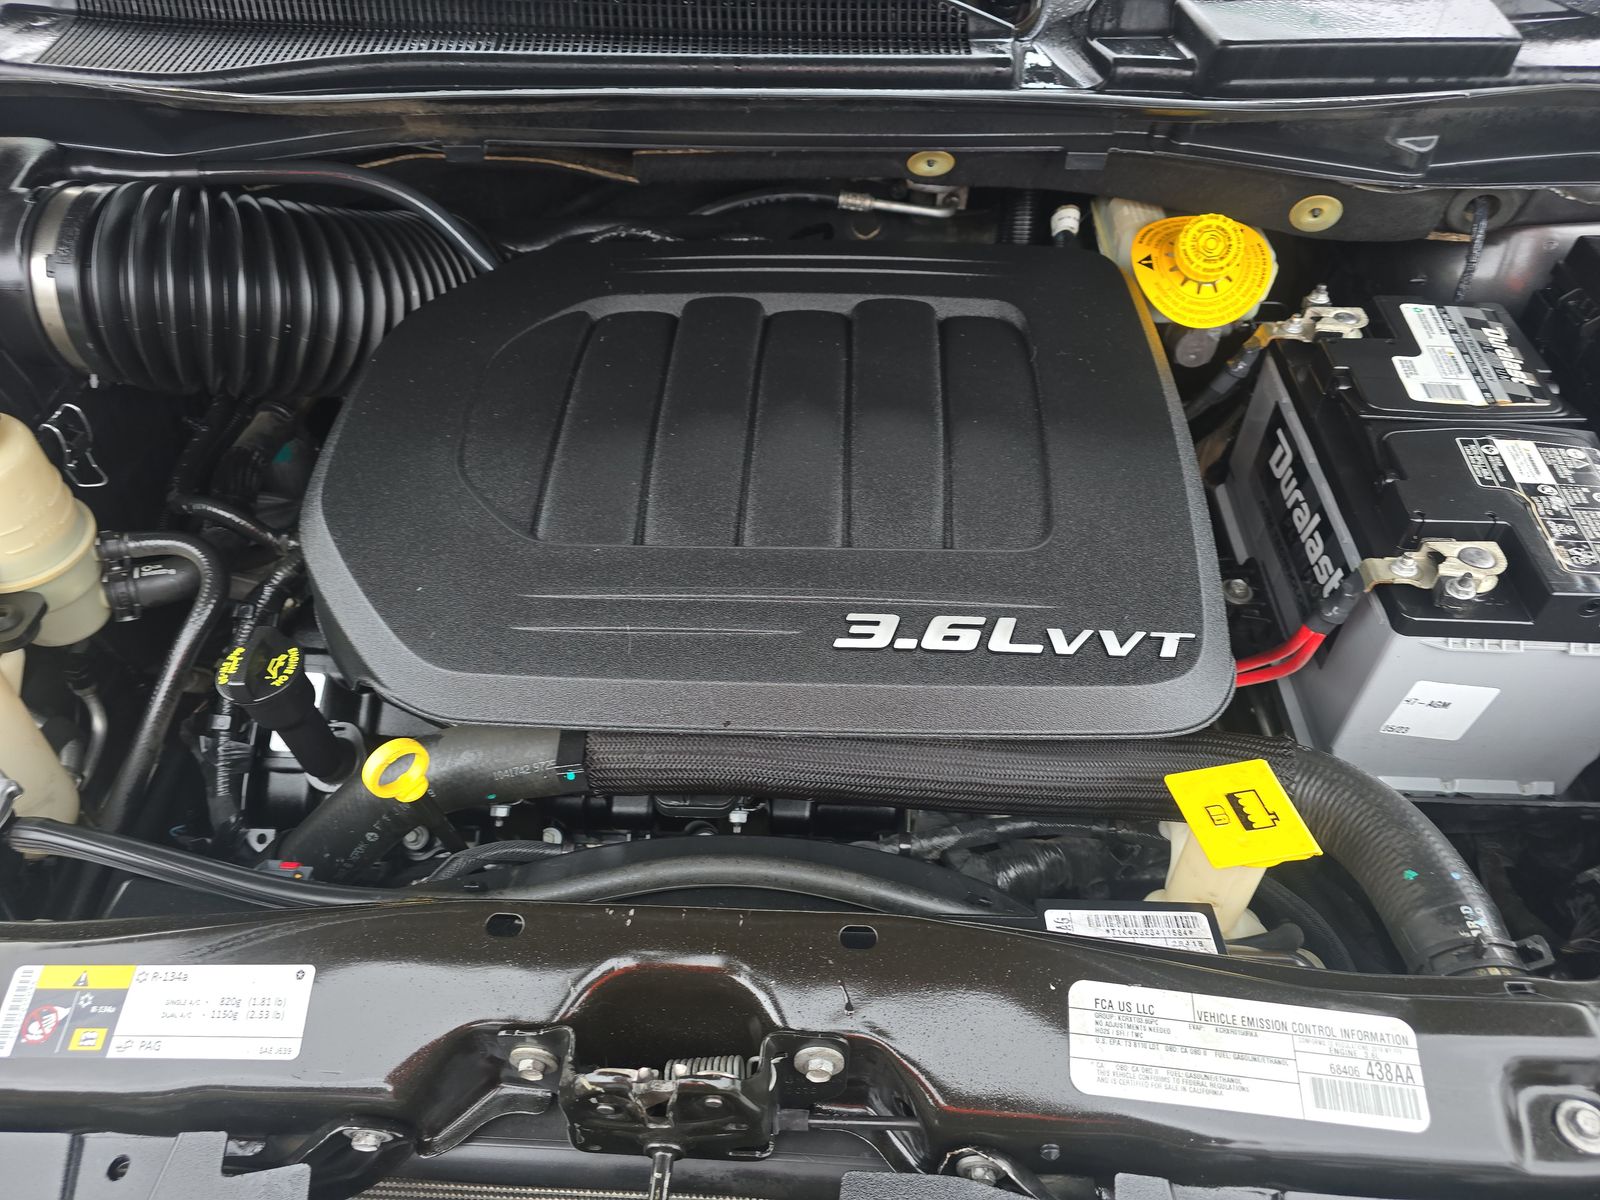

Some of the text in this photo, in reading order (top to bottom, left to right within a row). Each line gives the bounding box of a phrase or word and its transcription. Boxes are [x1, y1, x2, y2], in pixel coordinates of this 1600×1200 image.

[1481, 326, 1536, 387] Duralast
[1268, 428, 1344, 598] Duralast
[832, 612, 1196, 658] 3.6L VVT
[1094, 998, 1156, 1016] FCA US LLC
[1105, 1022, 1147, 1032] ADJUSTMENTS
[1148, 1026, 1171, 1035] NEEDED
[1196, 1010, 1409, 1046] VEHICLE EMISSION CONTROL INFORMATION
[139, 1040, 162, 1051] PAG
[1112, 1072, 1135, 1080] VEHICLE
[1137, 1074, 1171, 1084] CONFORMS
[1182, 1078, 1208, 1088] FEDERAL
[1329, 1061, 1416, 1084] 68406 438AA
[1119, 1079, 1150, 1089] CERTIFIED
[1189, 1086, 1224, 1096] CALIFORNIA
